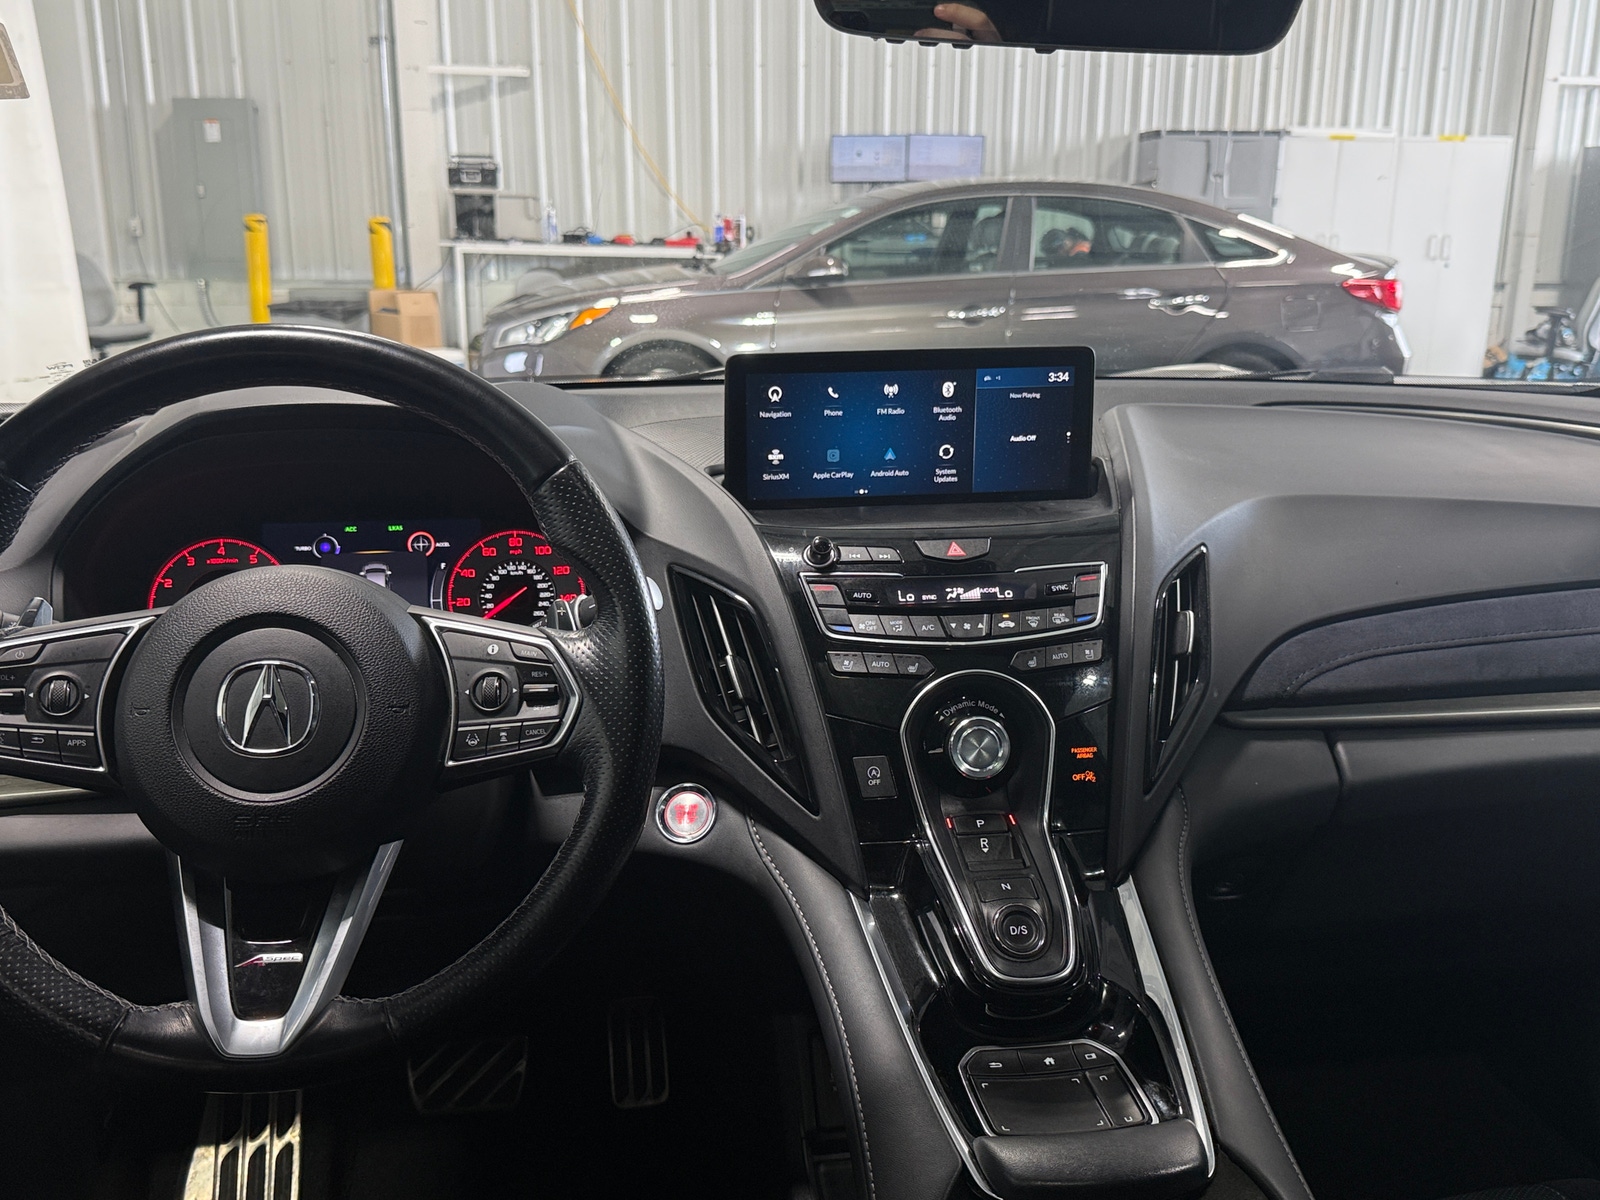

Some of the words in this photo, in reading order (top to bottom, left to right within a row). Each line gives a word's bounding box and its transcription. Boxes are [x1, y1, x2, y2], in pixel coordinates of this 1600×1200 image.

[1048, 372, 1070, 382] 3:34
[760, 410, 792, 419] Navigation
[762, 473, 789, 481] SiriusXM
[813, 472, 830, 480] Apple
[831, 471, 854, 479] CarPlay
[508, 538, 523, 547] 80
[217, 547, 226, 556] 4
[482, 547, 497, 557] 60
[534, 546, 552, 555] 100
[187, 557, 195, 566] 3
[249, 554, 258, 564] 5
[460, 569, 476, 578] 40
[553, 566, 570, 575] 120
[164, 579, 172, 588] 2
[898, 590, 915, 601] Lo
[996, 586, 1013, 598] Lo
[456, 598, 470, 606] 20
[943, 700, 976, 716] Dynamic
[978, 700, 999, 714] Mode
[1072, 773, 1086, 781] OFF
[976, 820, 985, 828] P
[980, 838, 989, 848] R
[1001, 883, 1011, 891] N
[1009, 925, 1028, 936] D/S
